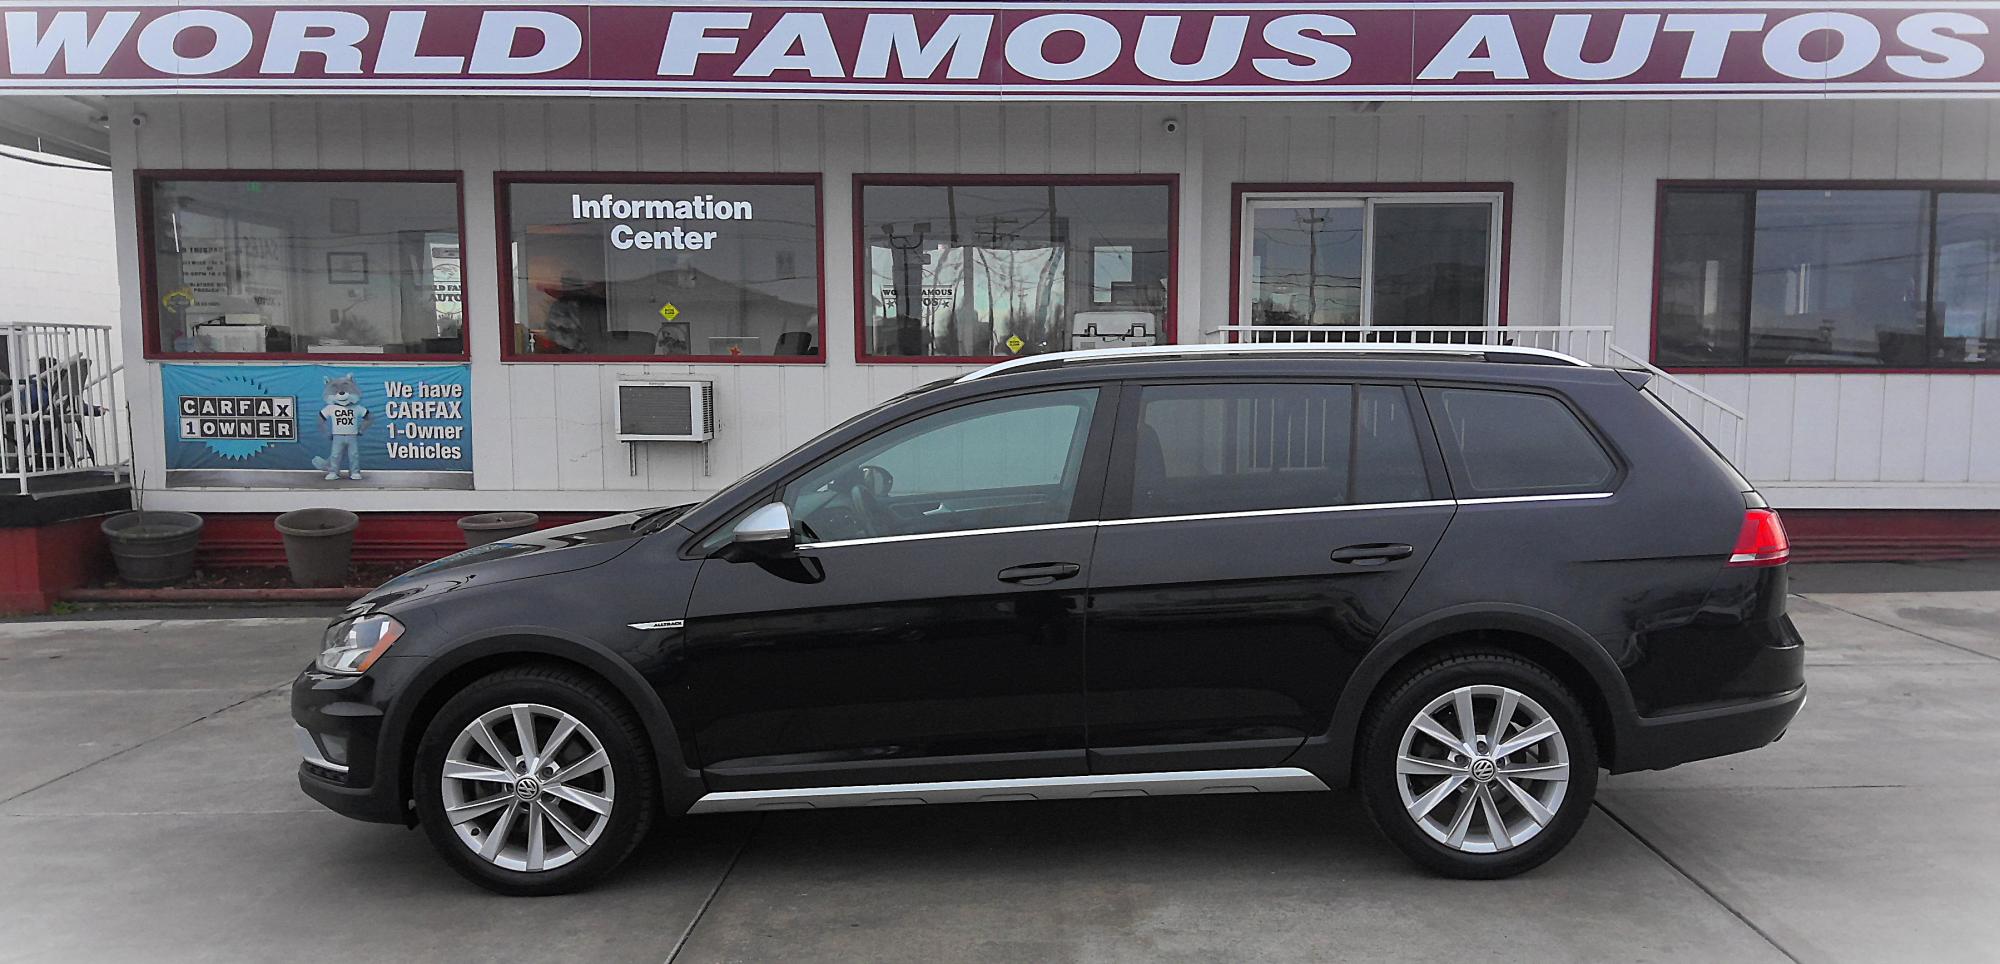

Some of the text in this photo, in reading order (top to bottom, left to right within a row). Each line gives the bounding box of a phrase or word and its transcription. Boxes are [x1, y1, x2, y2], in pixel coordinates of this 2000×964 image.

[4, 11, 1987, 82] WORLD FAMOUS AUTOS
[572, 194, 753, 220] Information
[610, 224, 717, 250] Center
[385, 381, 462, 398] We have
[181, 399, 291, 418] CARFAX
[334, 409, 354, 418] CAR
[386, 401, 462, 419] CARFAX
[336, 418, 354, 427] FOX
[386, 422, 462, 440] 1-Owner
[386, 442, 462, 460] Vehicles
